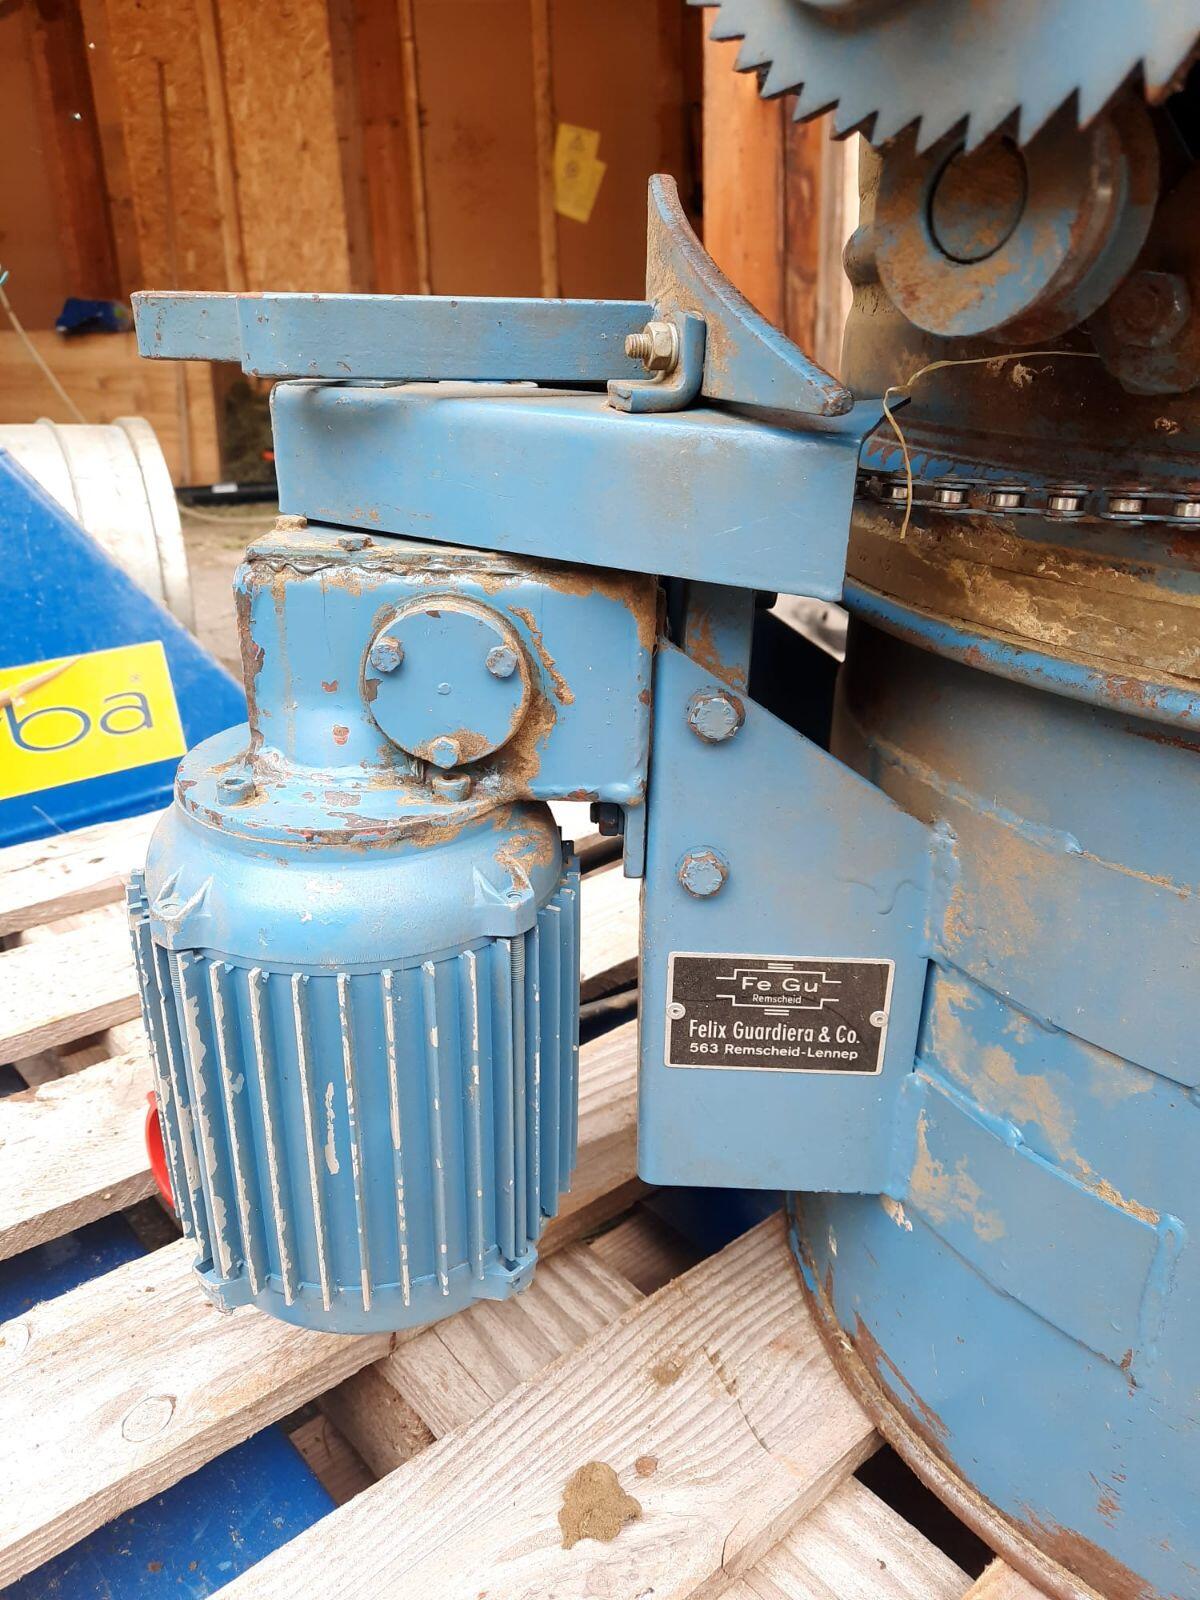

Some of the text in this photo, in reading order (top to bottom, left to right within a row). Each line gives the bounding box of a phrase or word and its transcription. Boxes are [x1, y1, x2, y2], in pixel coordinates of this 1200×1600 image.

[0, 691, 154, 752] ba
[741, 976, 819, 993] Fe Gu
[752, 993, 802, 1004] Remscheid
[689, 1019, 861, 1044] Felix Guardiera & Co.
[689, 1043, 859, 1062] 563 Remscheid-Lennep
